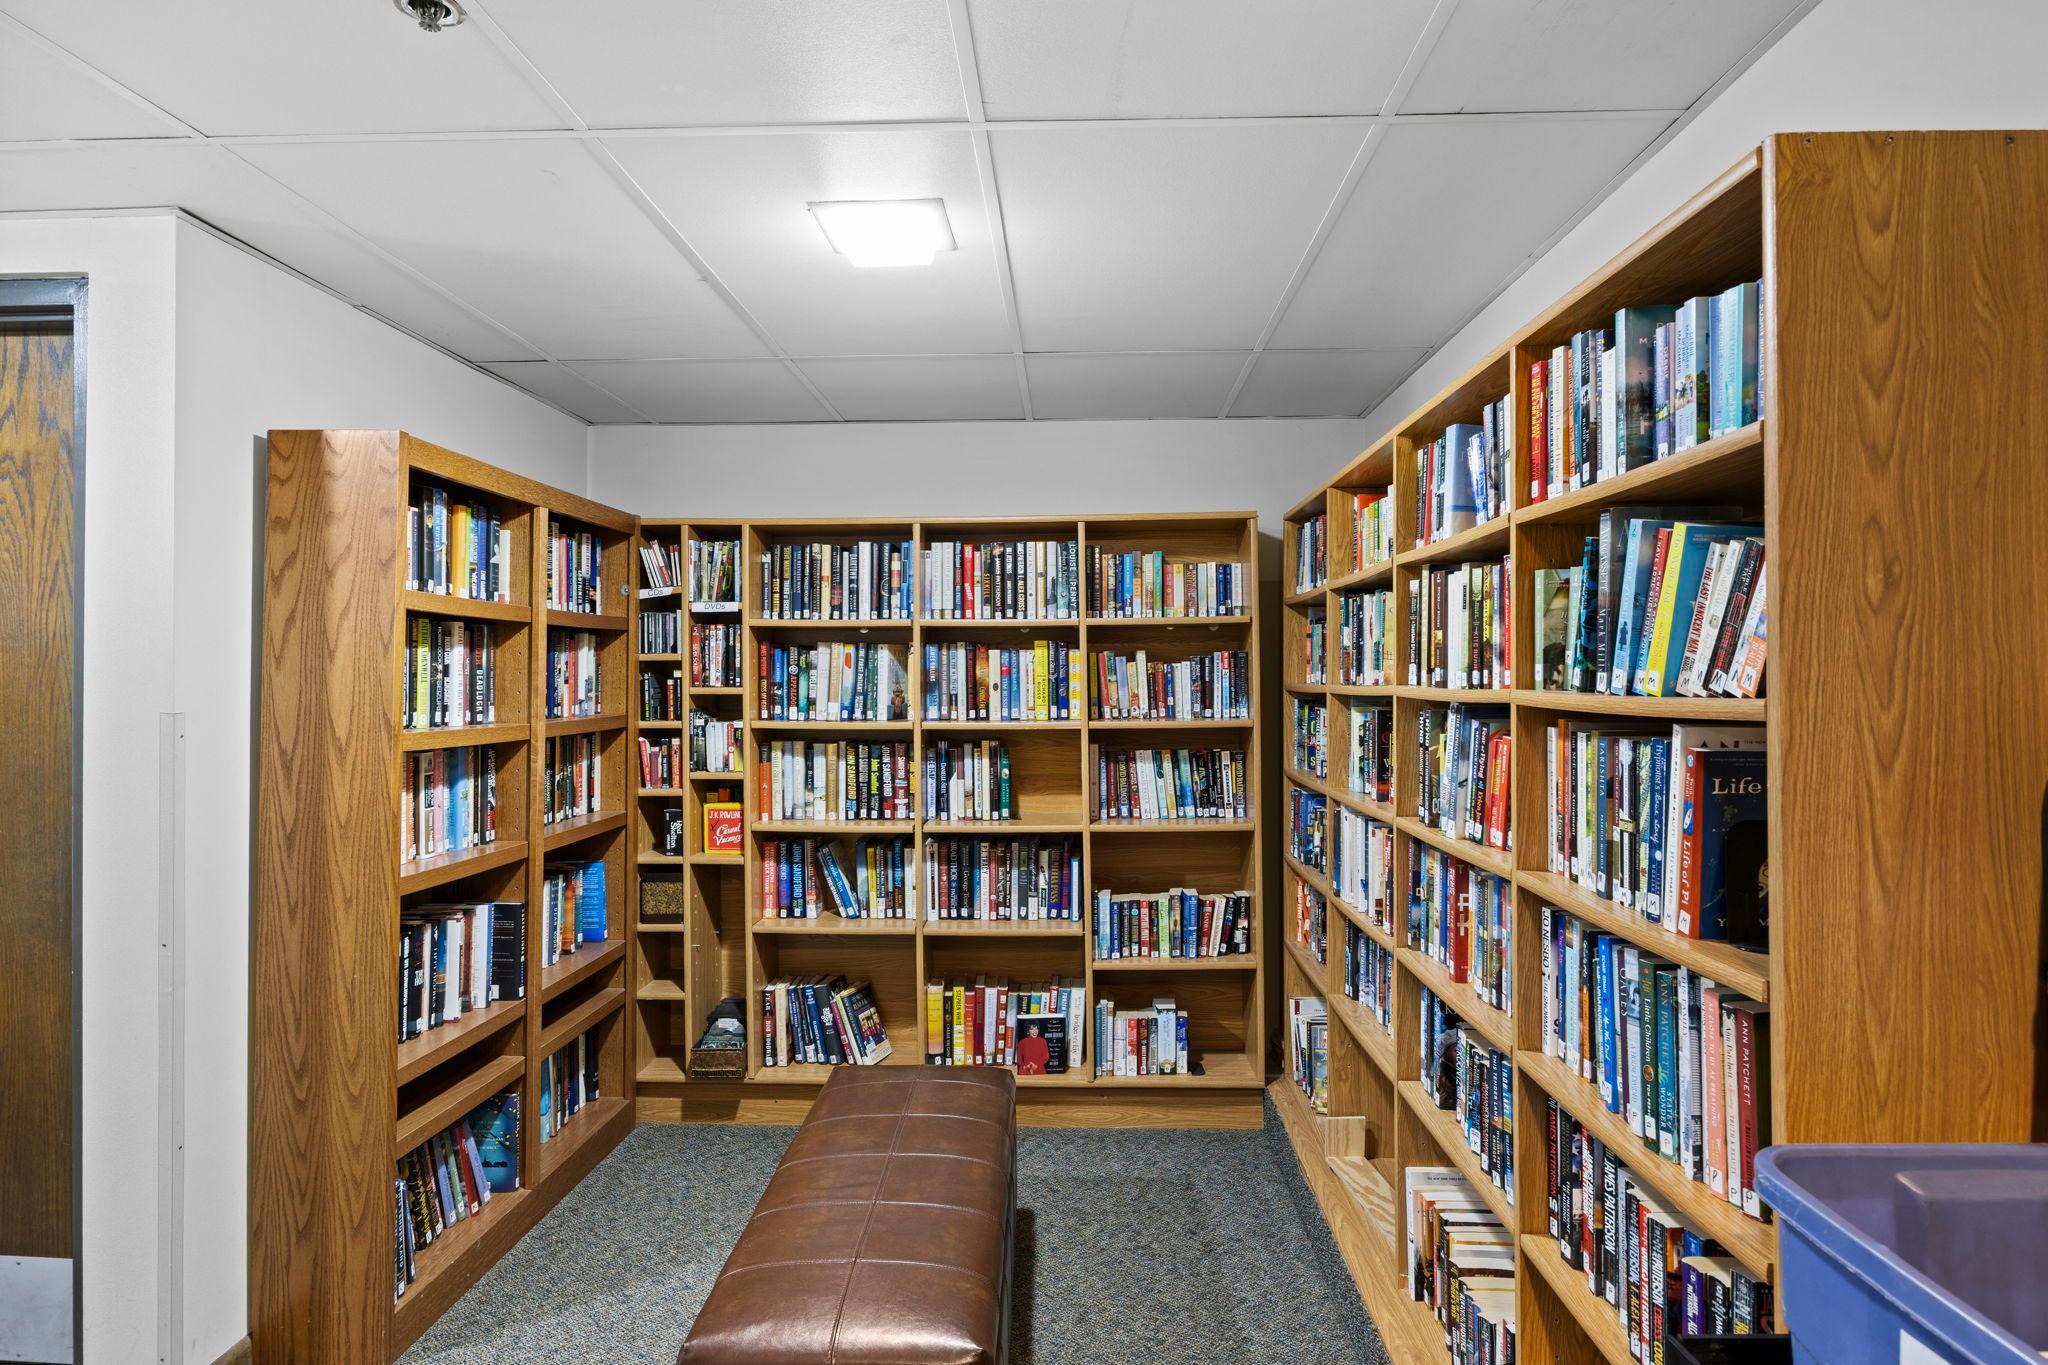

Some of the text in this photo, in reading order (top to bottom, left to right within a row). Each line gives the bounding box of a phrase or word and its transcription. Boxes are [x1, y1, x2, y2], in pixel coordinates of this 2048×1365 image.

[1600, 526, 1610, 591] AMAGANSETT
[1644, 540, 1662, 635] HAVE SOME QUESTIONS
[1597, 609, 1606, 637] Mark
[1687, 567, 1713, 654] THE LAST INNOCENT MAN
[847, 746, 856, 799] JOHN SANDFORD
[882, 746, 892, 796] JOHN SANDFORD
[1654, 745, 1663, 790] Hypnotist's
[1712, 777, 1762, 794] Life
[1648, 820, 1660, 844] story
[793, 844, 802, 897] JOHN SANDFORD
[1682, 871, 1689, 883] of
[1682, 890, 1689, 905] Pi
[1542, 911, 1550, 923] JO
[1644, 998, 1652, 1027] Little
[1660, 980, 1670, 1075] ANN PATCHETT
[1071, 1041, 1079, 1055] clay
[1644, 1028, 1652, 1061] Children
[1726, 1044, 1734, 1078] Patchett
[1710, 1057, 1716, 1068] US
[1710, 1072, 1716, 1081] AS
[1742, 1048, 1750, 1105] PATCHETT
[1710, 1086, 1718, 1126] BREATHING
[1605, 1157, 1615, 1255] JAMES PATTERSON
[1641, 1247, 1649, 1281] JAMES
[1653, 1258, 1663, 1307] PATTERSON
